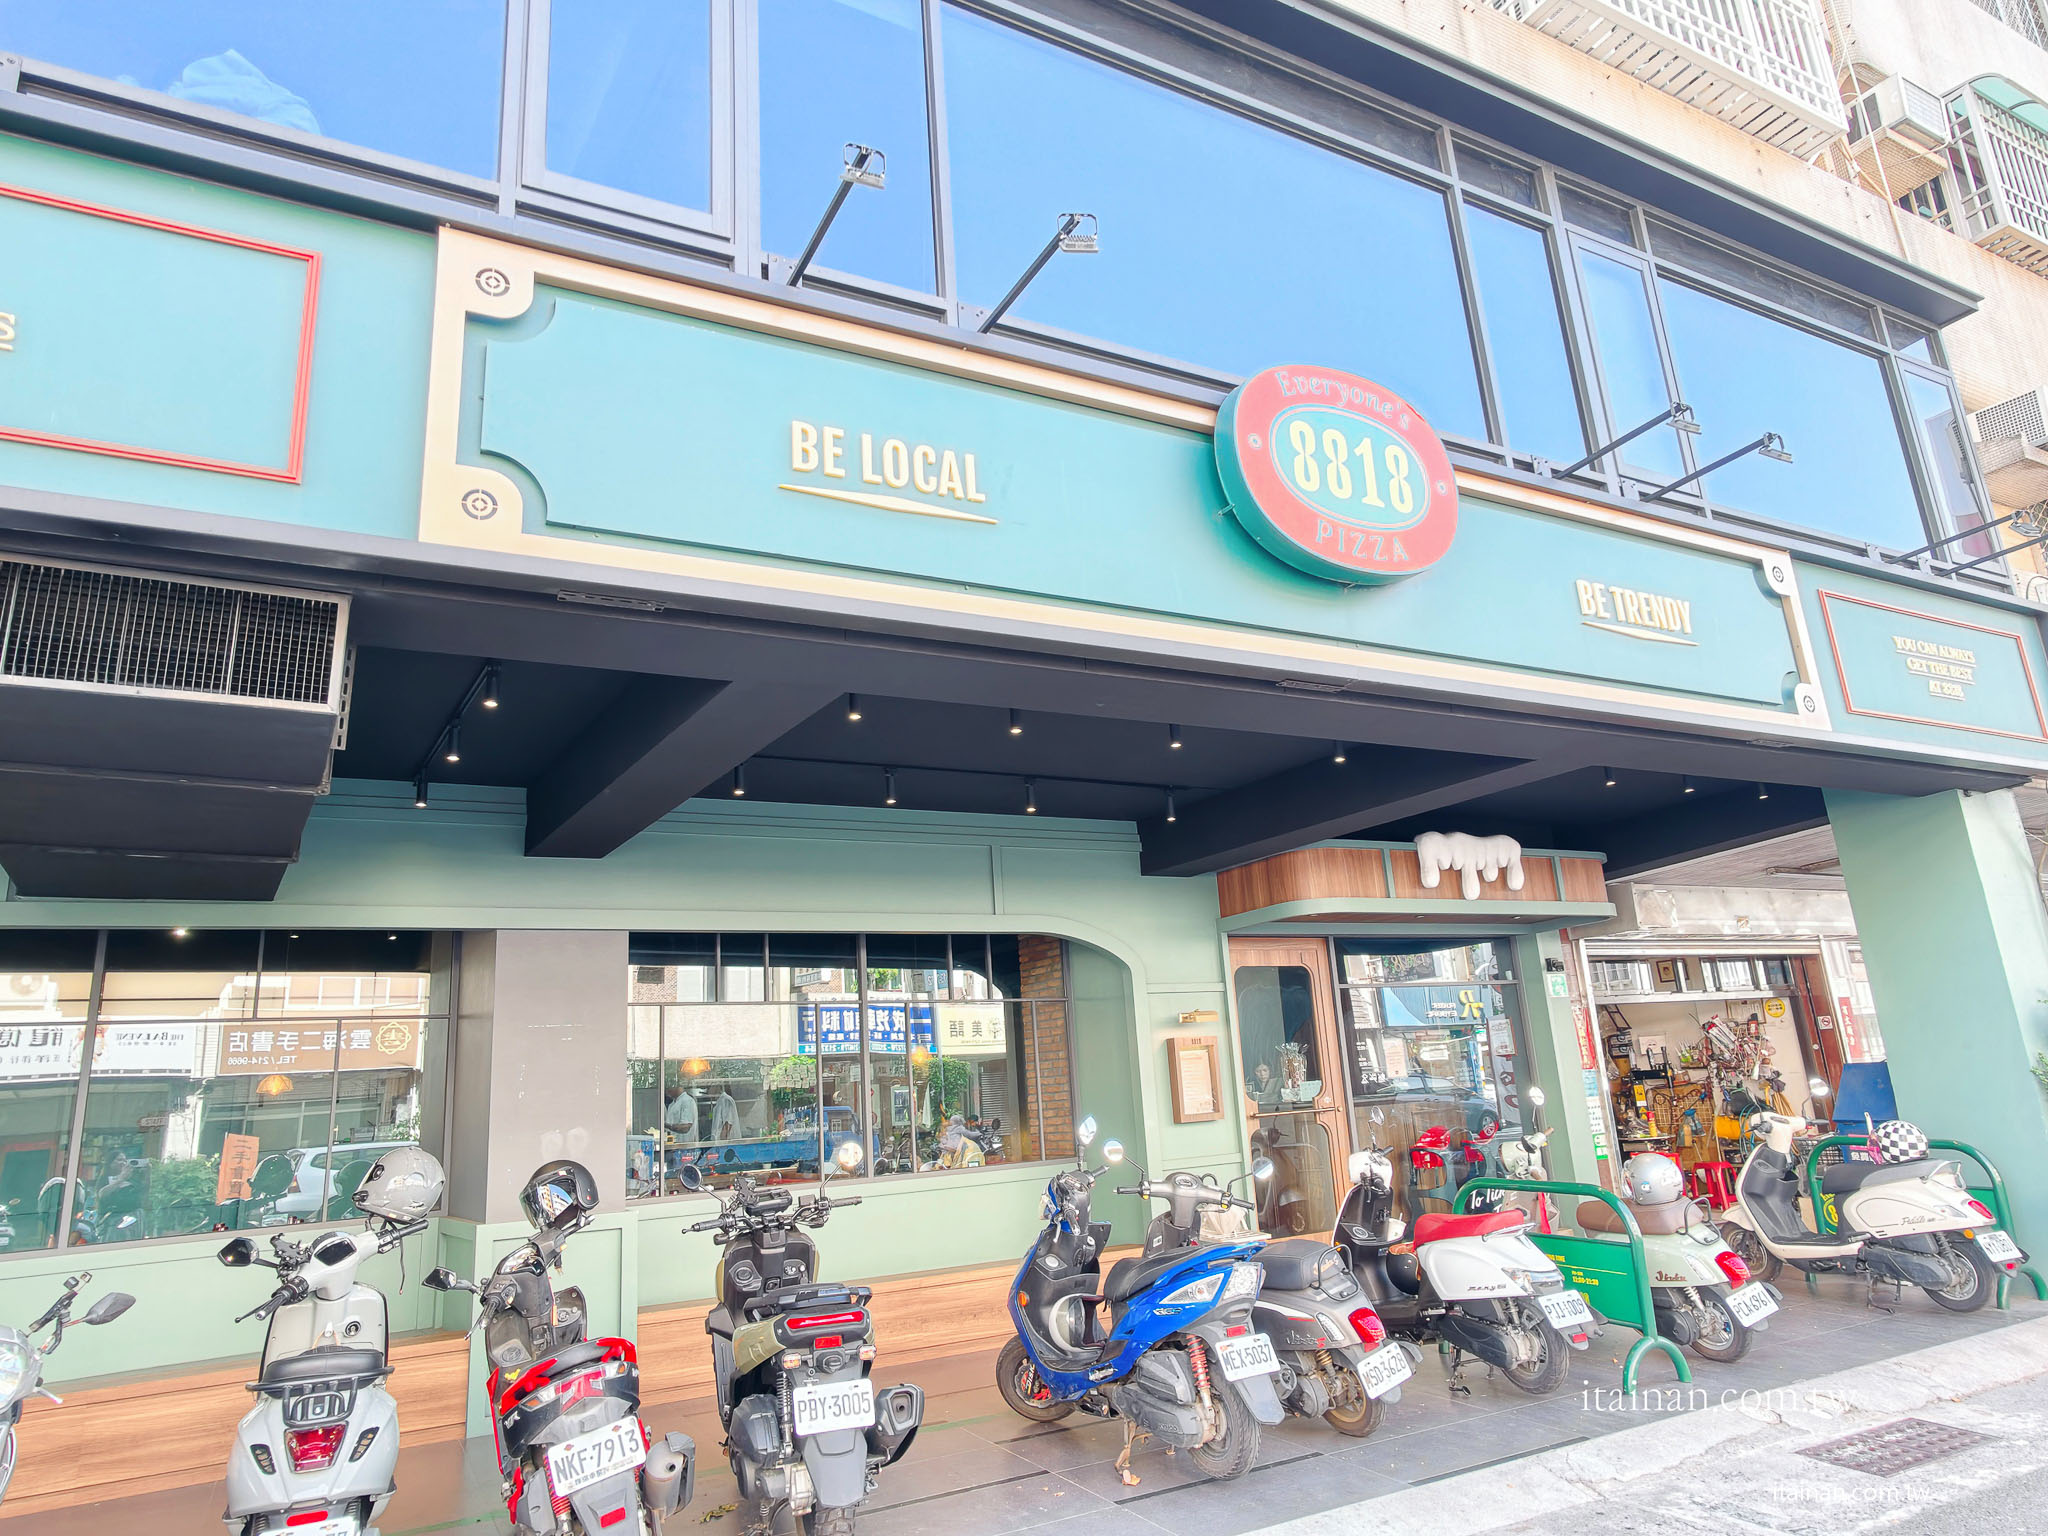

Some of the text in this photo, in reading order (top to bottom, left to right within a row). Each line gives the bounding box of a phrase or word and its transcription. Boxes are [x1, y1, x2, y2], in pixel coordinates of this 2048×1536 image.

[1275, 371, 1412, 431] Everyone's
[791, 420, 986, 503] BE LOCAL
[1289, 420, 1414, 514] 8818
[1316, 519, 1409, 562] PIZZA
[1575, 579, 1692, 634] BE TRENDY
[1891, 635, 1917, 652] YOU
[1470, 1189, 1485, 1210] To
